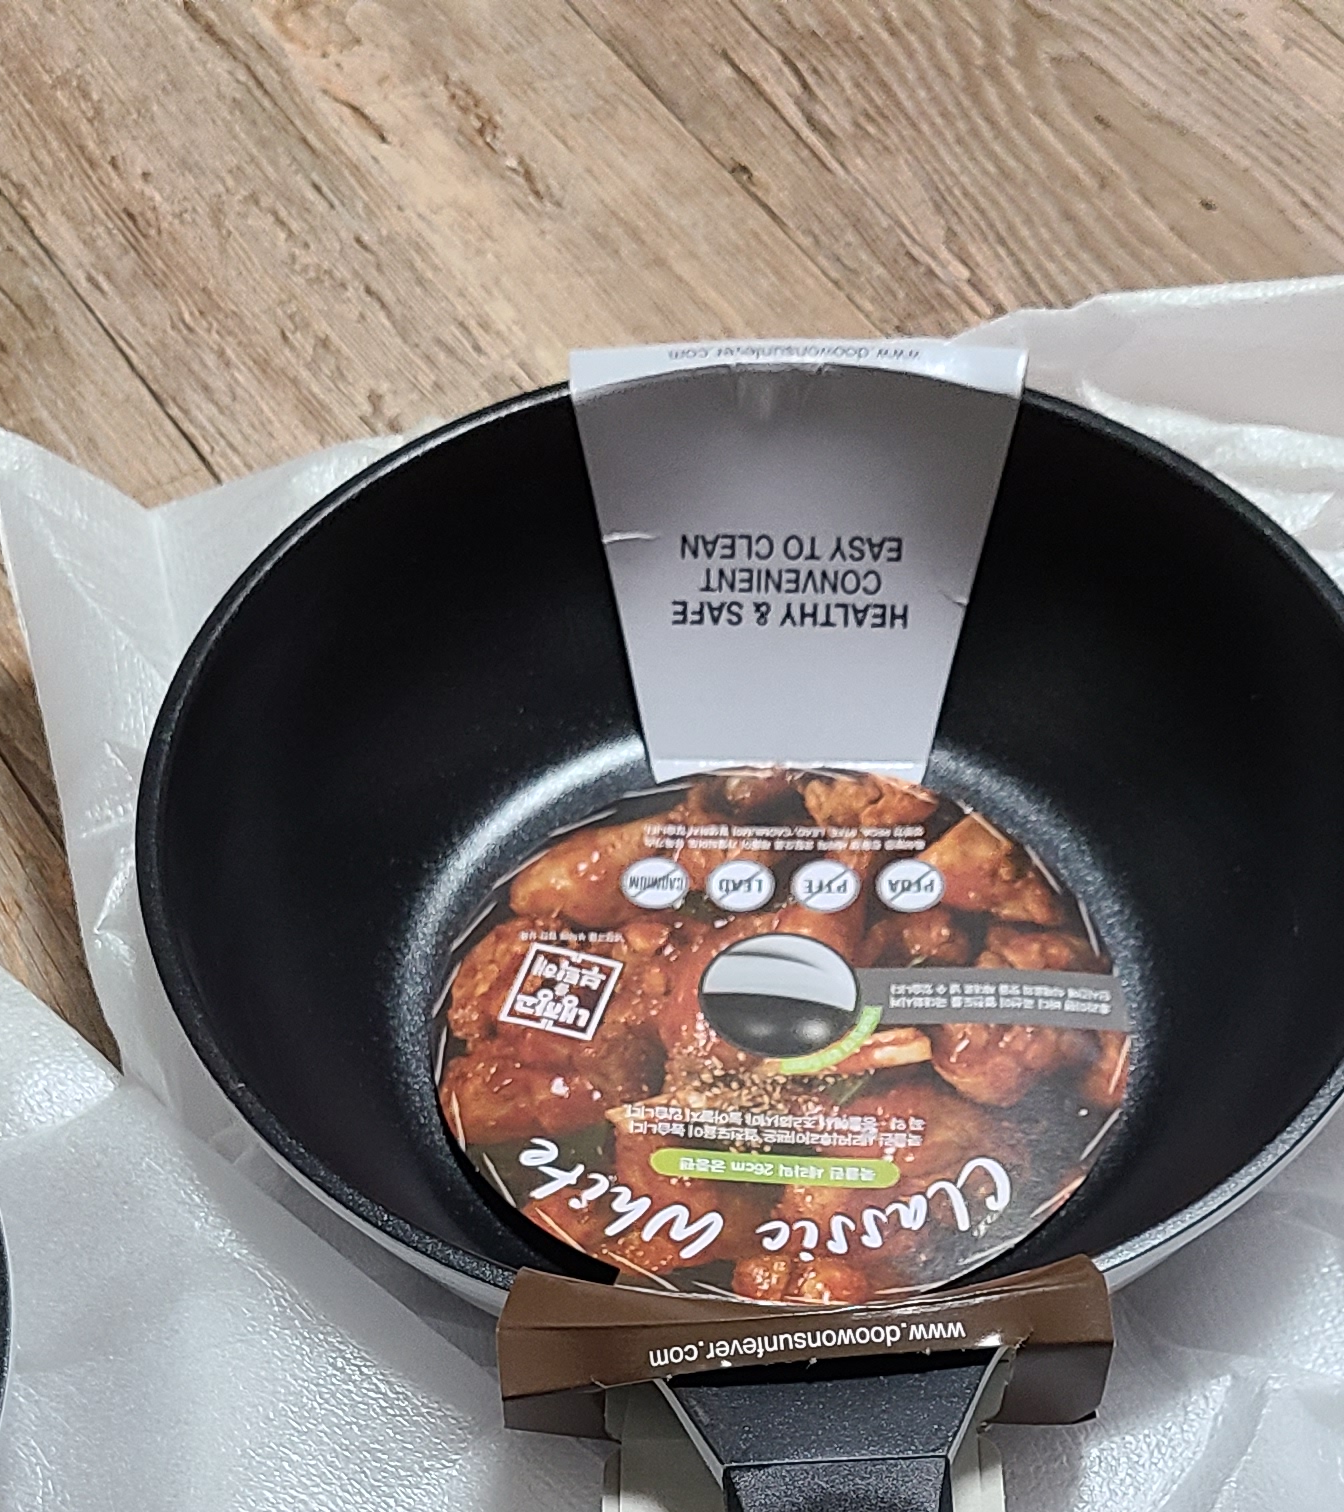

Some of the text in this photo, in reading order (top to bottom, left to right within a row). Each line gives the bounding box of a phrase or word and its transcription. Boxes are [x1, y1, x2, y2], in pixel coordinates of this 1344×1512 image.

[679, 533, 902, 562] EASY TO CLEAN
[699, 567, 881, 595] CONVENIENT
[670, 600, 909, 629] HEALTHY & SAFE
[717, 877, 763, 892] LEAD
[802, 877, 847, 893] PTFE
[530, 953, 606, 990] 부탁해
[512, 987, 590, 1027] 냉장고
[730, 1158, 774, 1177] 26cm
[519, 1138, 1011, 1261] Classic White
[649, 1321, 966, 1368] www.doowonsunfever.com
